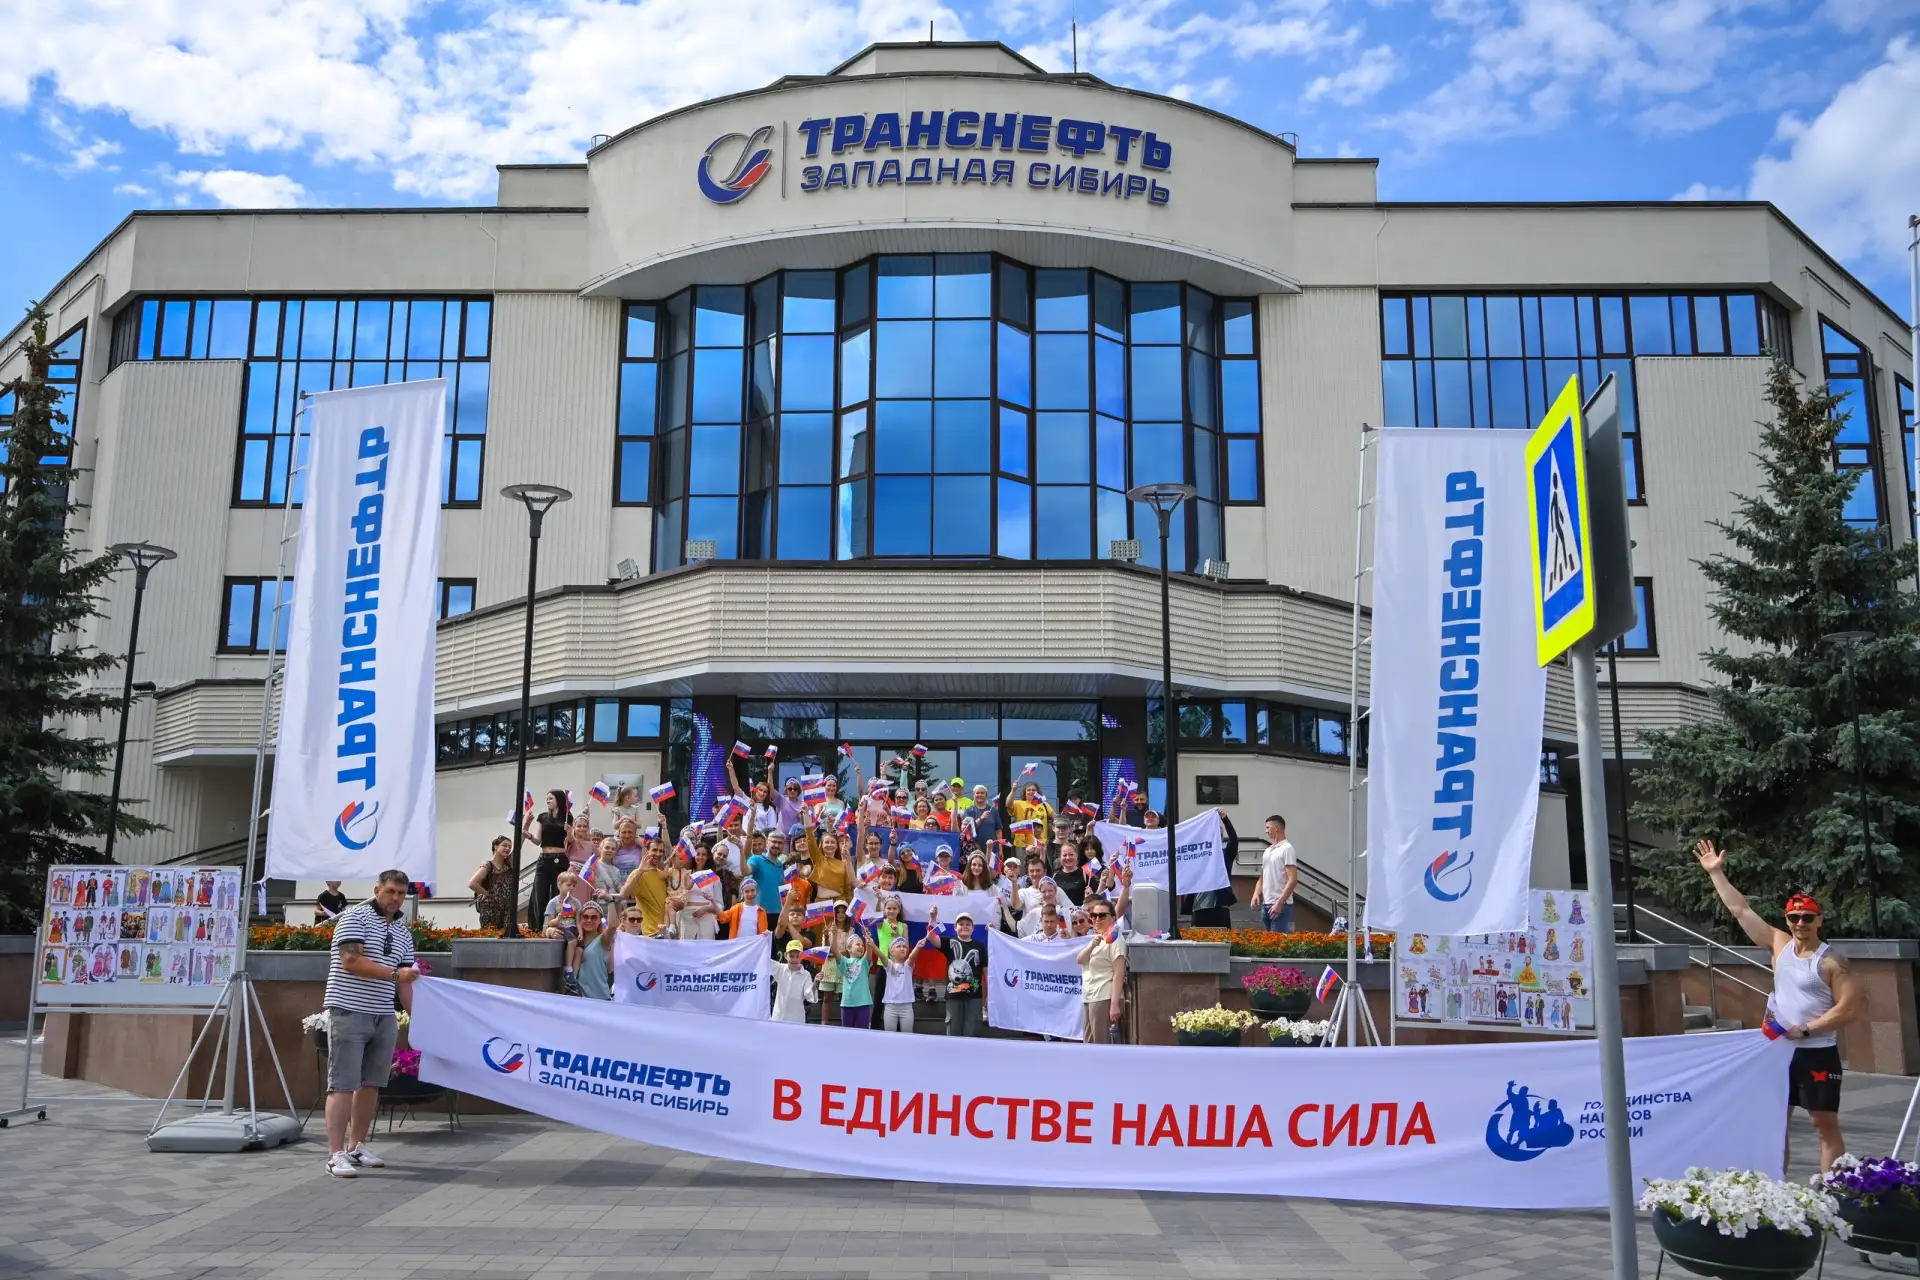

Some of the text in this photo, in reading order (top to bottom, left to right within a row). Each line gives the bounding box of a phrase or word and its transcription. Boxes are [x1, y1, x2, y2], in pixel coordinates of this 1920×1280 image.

[798, 111, 1172, 170] ТРАНСНЕФТЬ
[800, 158, 1170, 204] ЗАПАДНАЯ СИБИРЬ
[1136, 840, 1213, 860] ТРАННЕФТЬ
[1139, 850, 1213, 868] ЗАПАДЯ СИБИРЬ
[664, 972, 757, 984] ТРАНСНЕФТЬ
[1024, 970, 1083, 986] ТРАНСНЕФТ
[665, 984, 757, 993] ЗАПАДНАЯ СИБИРЬ
[1024, 982, 1063, 994] ЗАПАДНАЯ
[535, 1047, 731, 1097] ТРАНСНЕФТЬ
[538, 1071, 729, 1116] ЗАПАДНАЯ СИБИРЬ
[1626, 1091, 1692, 1108] ДИНСТВА
[773, 1079, 1436, 1148] В ЕДИНСТВЕ НАША СИЛА
[1580, 1109, 1652, 1124] НАОВ
